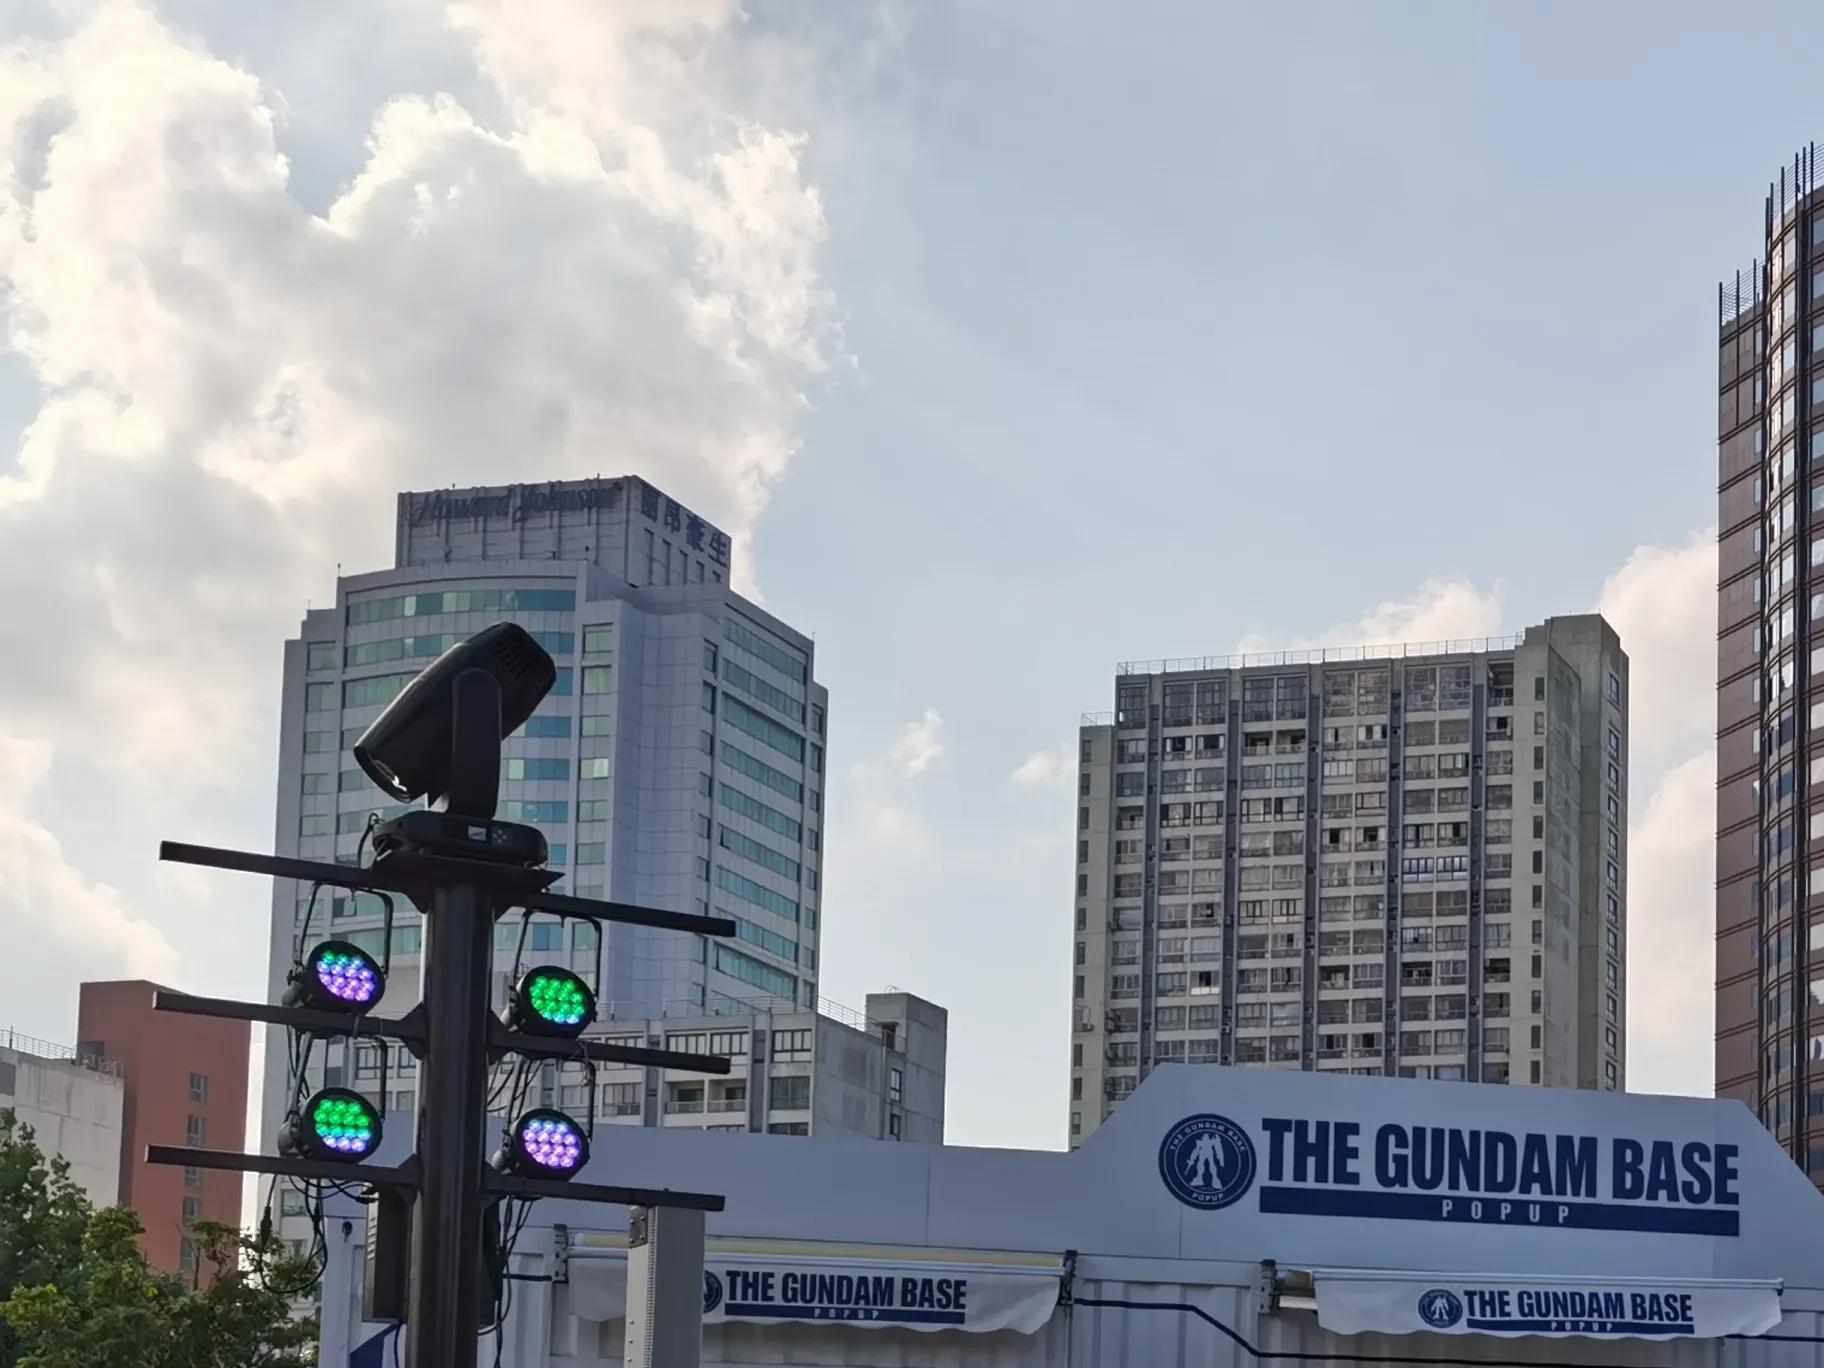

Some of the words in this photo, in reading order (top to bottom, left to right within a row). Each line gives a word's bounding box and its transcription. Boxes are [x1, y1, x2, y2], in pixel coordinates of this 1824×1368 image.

[1262, 1118, 1360, 1185] THE
[1375, 1123, 1598, 1198] GUNDAM
[1612, 1138, 1739, 1205] BASE
[1442, 1199, 1569, 1224] POPUP
[726, 1270, 775, 1302] THE
[781, 1272, 895, 1307] GUNDAM
[901, 1277, 967, 1309] BASE
[1463, 1290, 1511, 1318] THE
[1517, 1290, 1626, 1320] GUNDAM
[1631, 1293, 1694, 1322] BASE
[1551, 1322, 1613, 1333] POPUP
